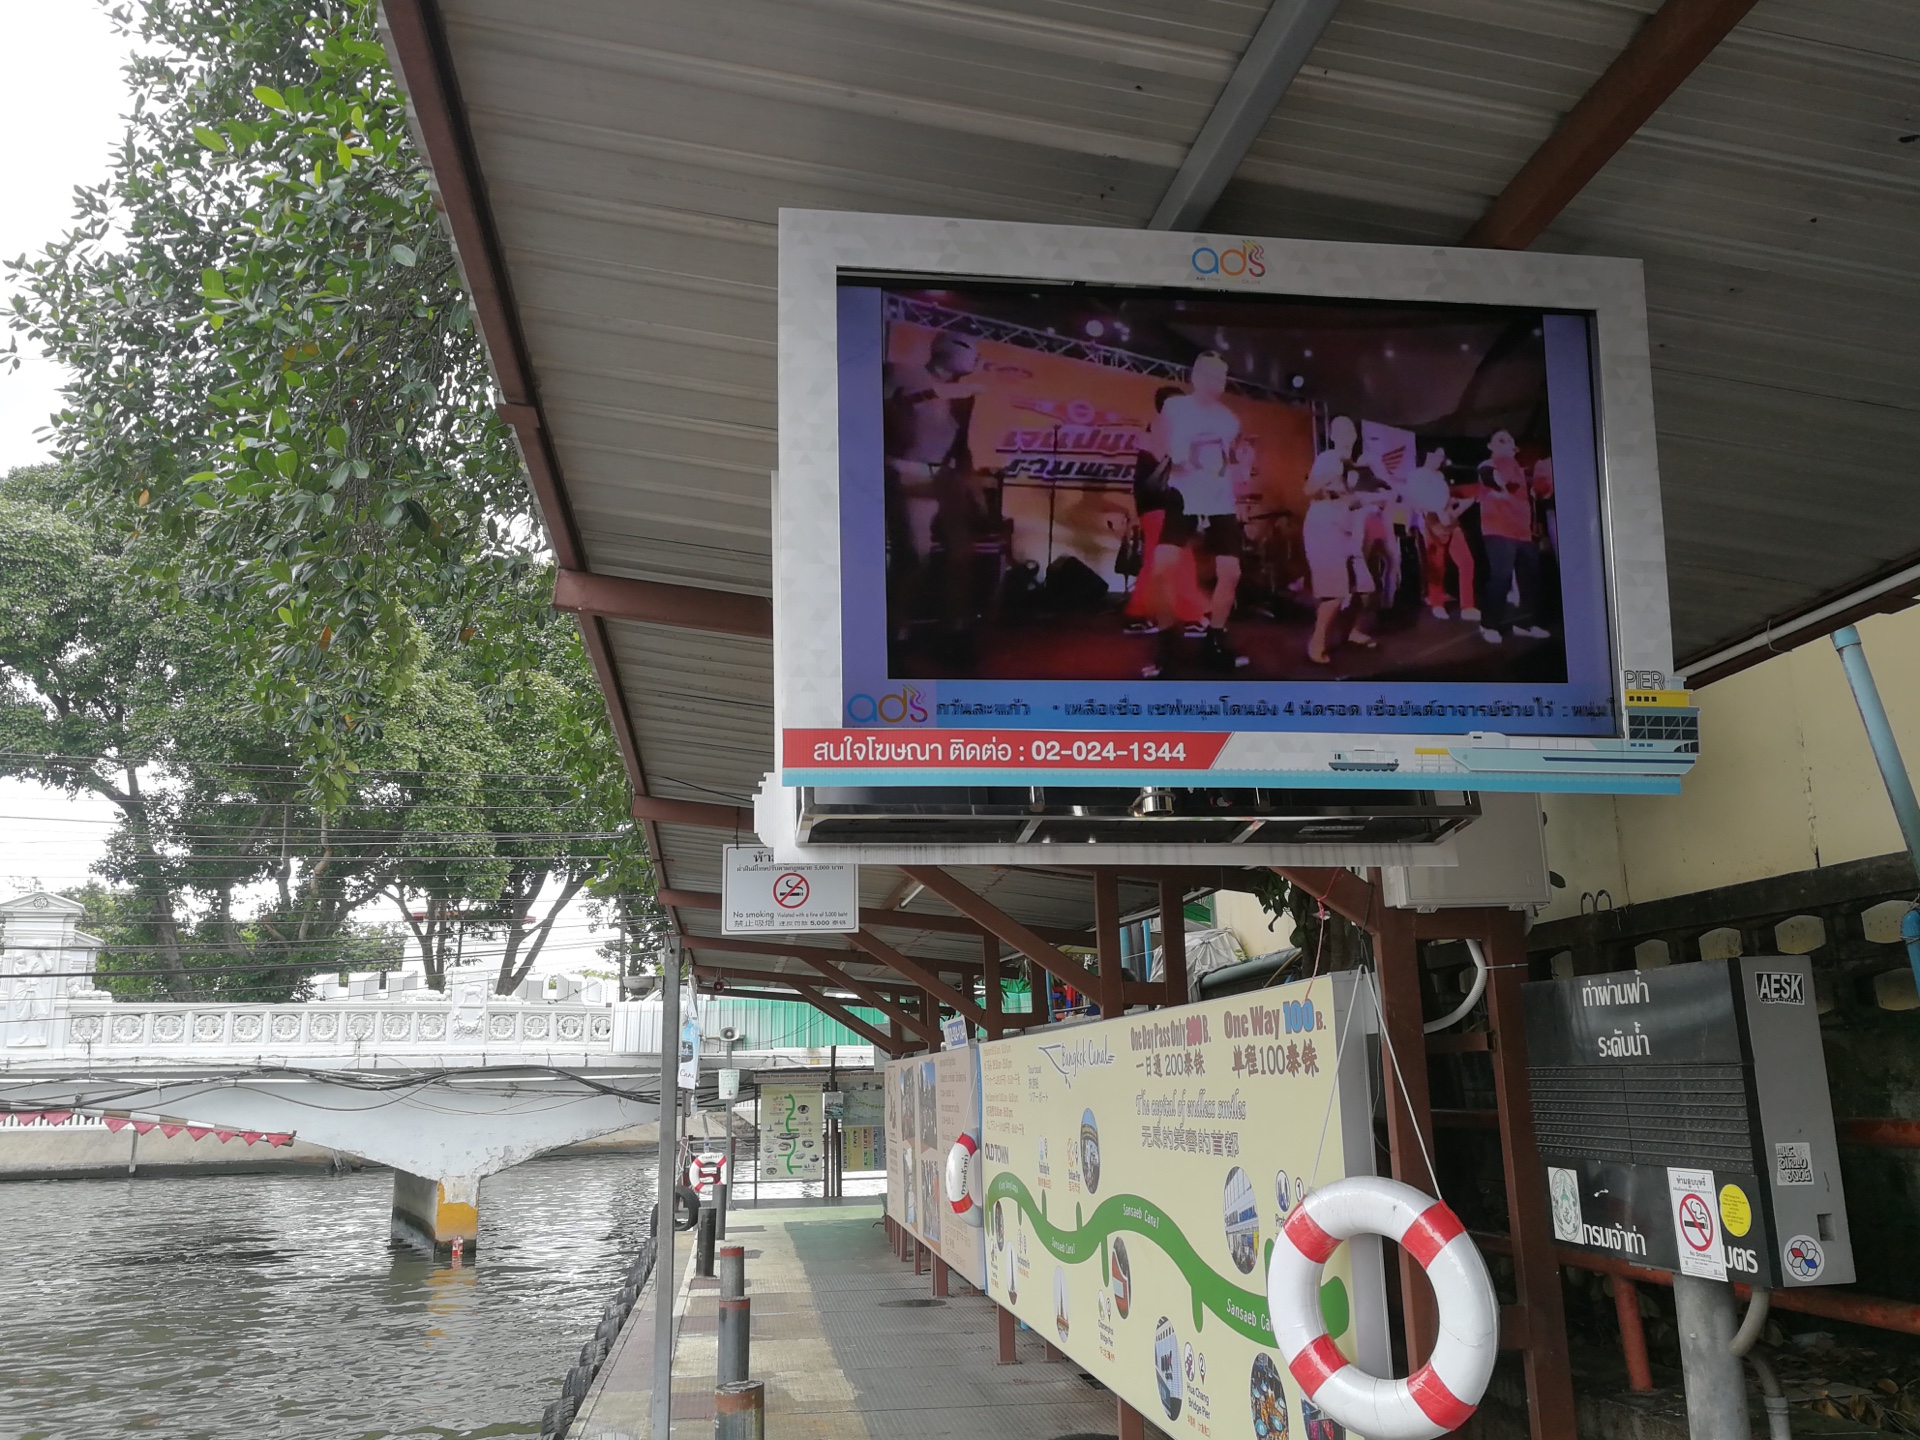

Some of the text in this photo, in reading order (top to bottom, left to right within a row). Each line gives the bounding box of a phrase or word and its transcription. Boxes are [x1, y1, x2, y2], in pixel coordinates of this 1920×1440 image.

[1191, 239, 1266, 278] ads
[1283, 701, 1295, 716] 4
[813, 735, 943, 761] สนใจโฆษณา
[950, 736, 1012, 762] ติดต่อ
[1031, 740, 1187, 762] 02-024-1344
[733, 919, 775, 928] 禁止吸烟
[745, 911, 775, 919] smoking
[1582, 969, 1650, 1007] ท่าผ่านฟ้า
[1760, 974, 1802, 999] AESK
[1224, 998, 1327, 1040] One Way 100 B.
[1130, 1026, 1142, 1052] One
[1142, 1024, 1154, 1054] Day
[1154, 1022, 1171, 1049] Pass
[1170, 1018, 1186, 1051] Only
[1598, 1021, 1651, 1058] ระดับน้ำ
[1231, 1038, 1320, 1079] 单程100泰铢
[1136, 1087, 1246, 1128] The capital of endless smiles
[985, 1142, 1009, 1165] OLD TOWN
[1123, 1203, 1160, 1230] Sansaeb Canal
[1582, 1222, 1647, 1256] กรมเจ้าท่า
[1226, 1298, 1257, 1327] Sansaeb
[1186, 1382, 1209, 1407] Hua Chang
[1188, 1396, 1202, 1415] Bridge
